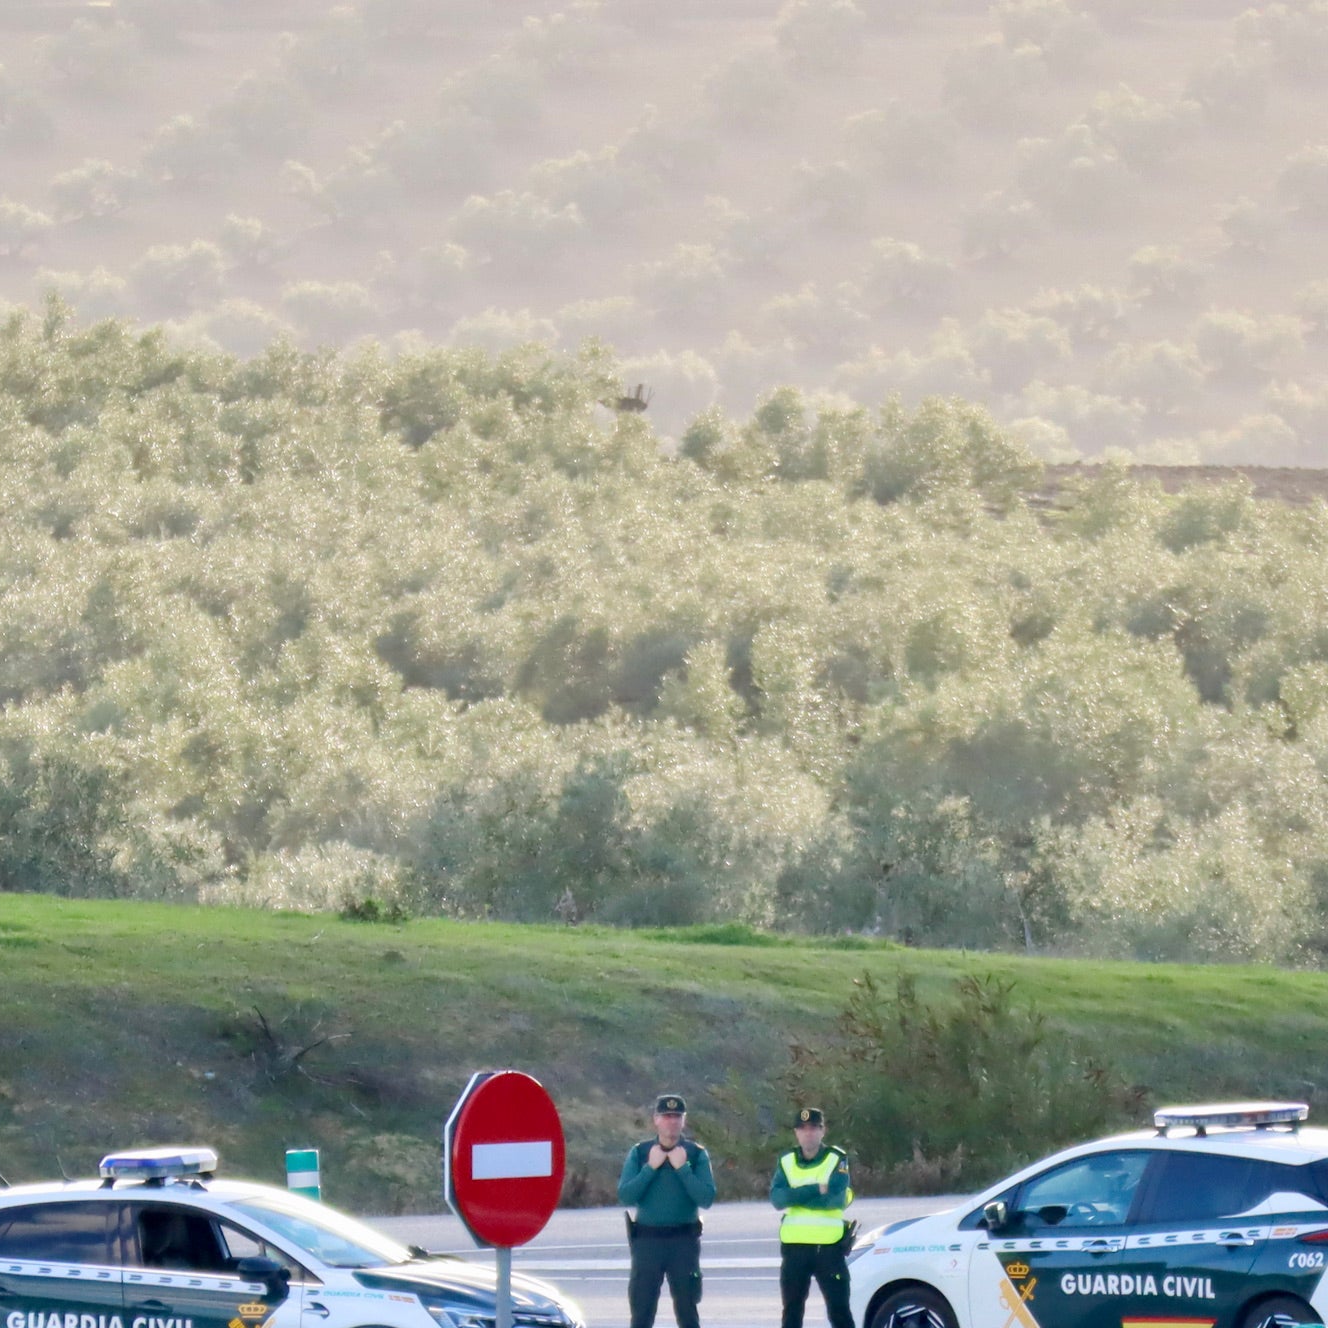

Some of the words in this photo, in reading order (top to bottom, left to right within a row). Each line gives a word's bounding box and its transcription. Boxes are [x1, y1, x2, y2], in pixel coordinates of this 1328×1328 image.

[1297, 1252, 1324, 1268] 062
[1061, 1274, 1158, 1296] GUARDIA
[1163, 1276, 1216, 1299] CIVIL
